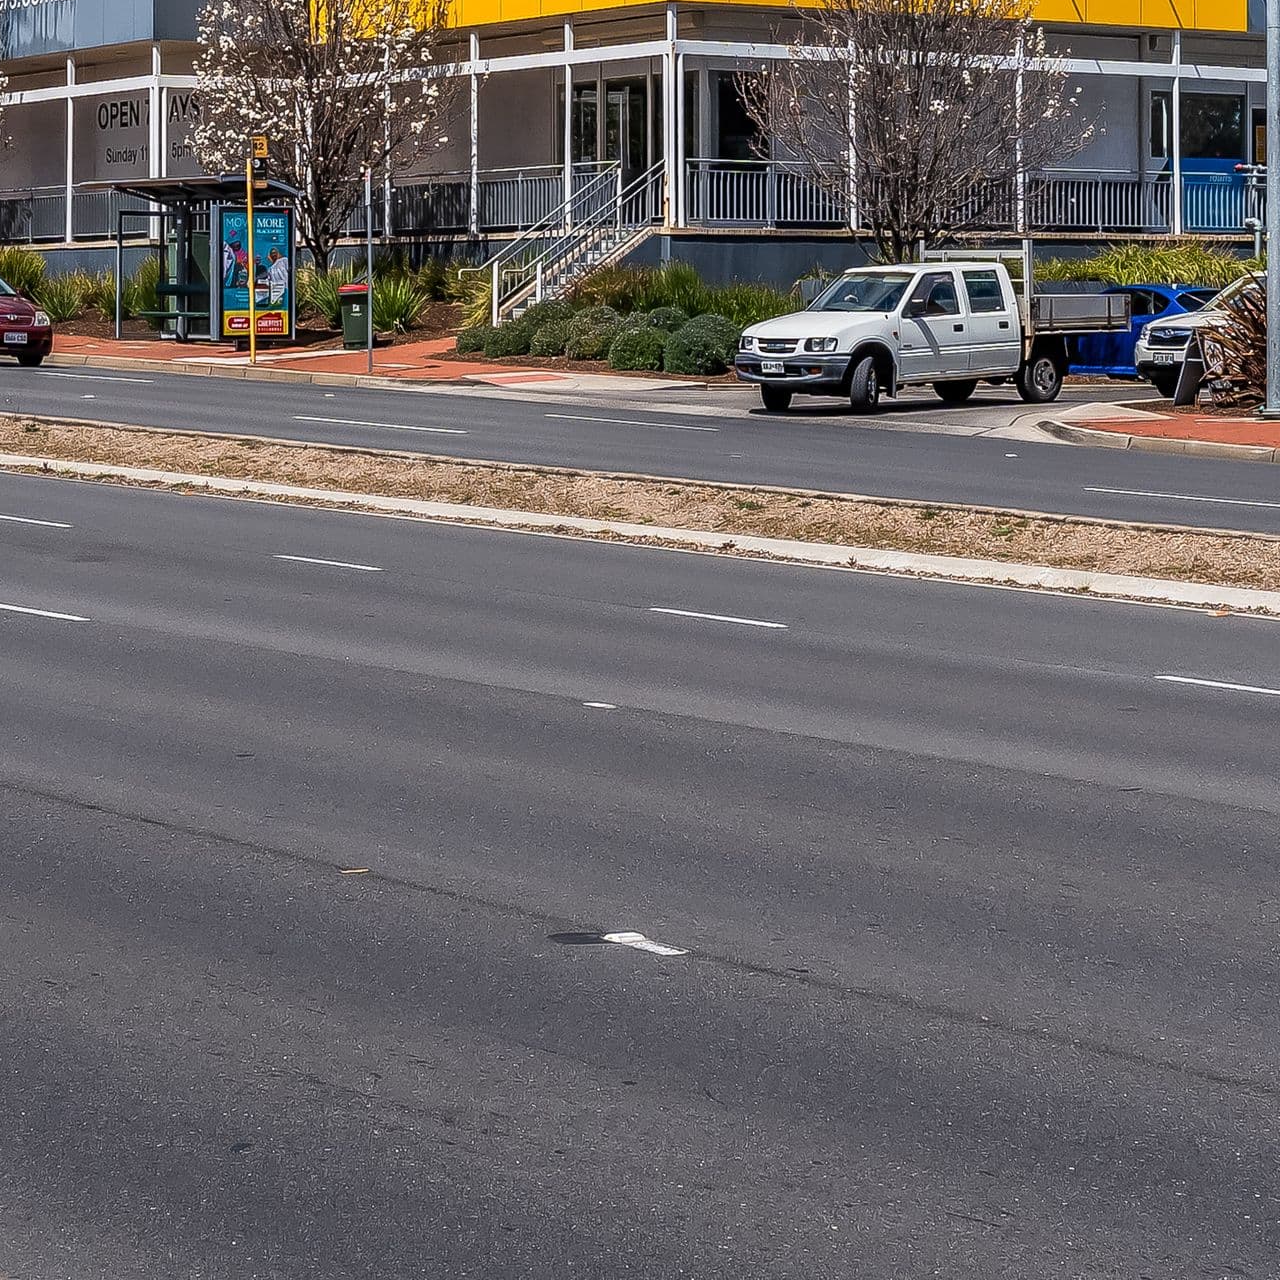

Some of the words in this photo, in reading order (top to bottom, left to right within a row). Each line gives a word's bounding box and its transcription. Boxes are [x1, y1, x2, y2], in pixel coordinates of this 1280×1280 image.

[97, 100, 140, 130] OPEN
[168, 93, 201, 123] AYS
[105, 147, 138, 165] Sunday
[256, 218, 285, 228] MORE
